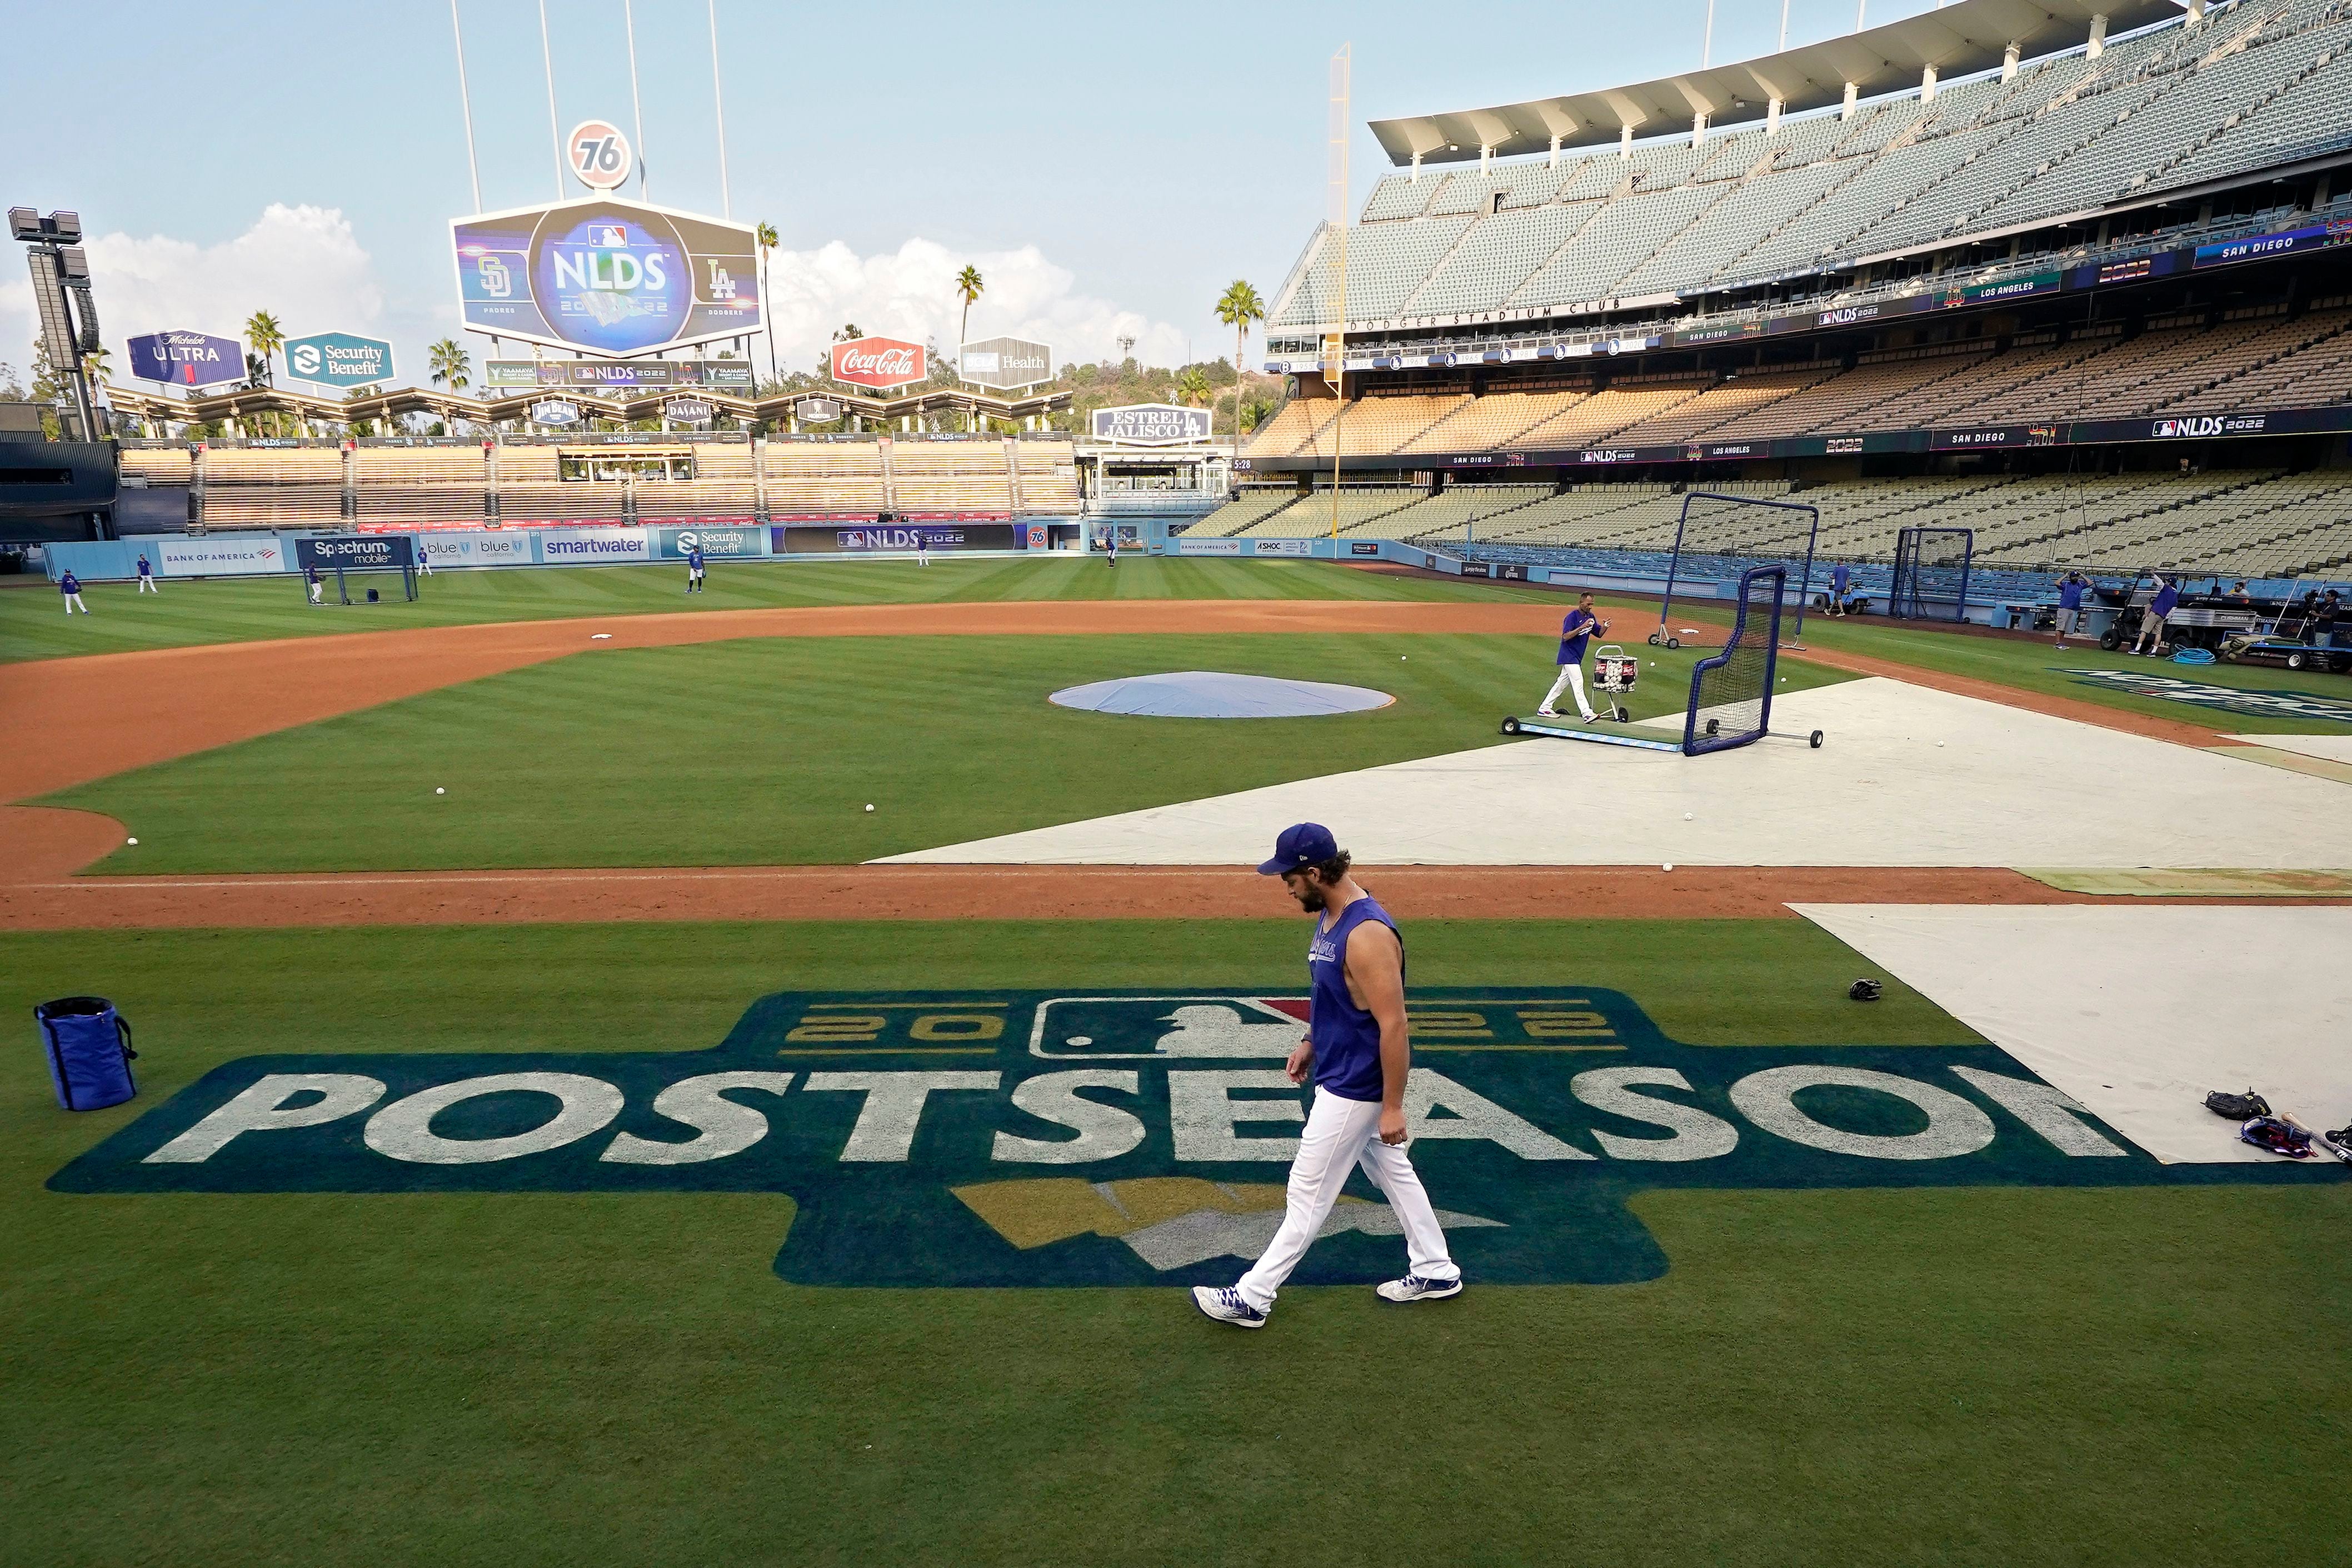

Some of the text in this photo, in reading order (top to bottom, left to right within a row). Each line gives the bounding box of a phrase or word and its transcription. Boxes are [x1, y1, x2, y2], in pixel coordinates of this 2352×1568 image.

[578, 136, 622, 172] 76
[2223, 237, 2293, 258] SAN DIEGO
[553, 251, 666, 291] NLDS
[707, 258, 735, 298] LA
[1980, 282, 2034, 298] LOS ANGELES
[1350, 299, 1620, 331] DODGER STADIUM CLUB
[1831, 307, 1879, 324] NLDS 2022
[162, 334, 206, 345] Michelob
[1689, 330, 1727, 341] SAN DIEGO
[152, 347, 220, 362] ULTRA
[324, 345, 383, 362] Security
[328, 361, 378, 375] Benefit
[840, 347, 916, 376] Coca-Cola
[966, 355, 1045, 368] UCLA Health
[596, 366, 635, 380] NLDS
[536, 405, 551, 420] JIM
[551, 402, 576, 420] BEAM
[670, 404, 708, 417] DASANI
[1104, 425, 1180, 438] JALISCO
[2175, 416, 2265, 437] NLDS 2022
[1952, 432, 2005, 443] SAN DIEGO
[1826, 438, 1863, 453] 2022
[1593, 451, 1617, 463] NLDS
[1234, 460, 1251, 469] 5:28
[701, 531, 744, 543] Security
[867, 530, 965, 548] NLDS 2022
[1030, 531, 1044, 543] 76
[314, 541, 387, 556] Spectrum
[428, 542, 457, 554] blue
[481, 541, 510, 552] blue
[547, 538, 643, 555] smartwater
[703, 543, 740, 555] Benefit
[354, 553, 388, 565] mobile
